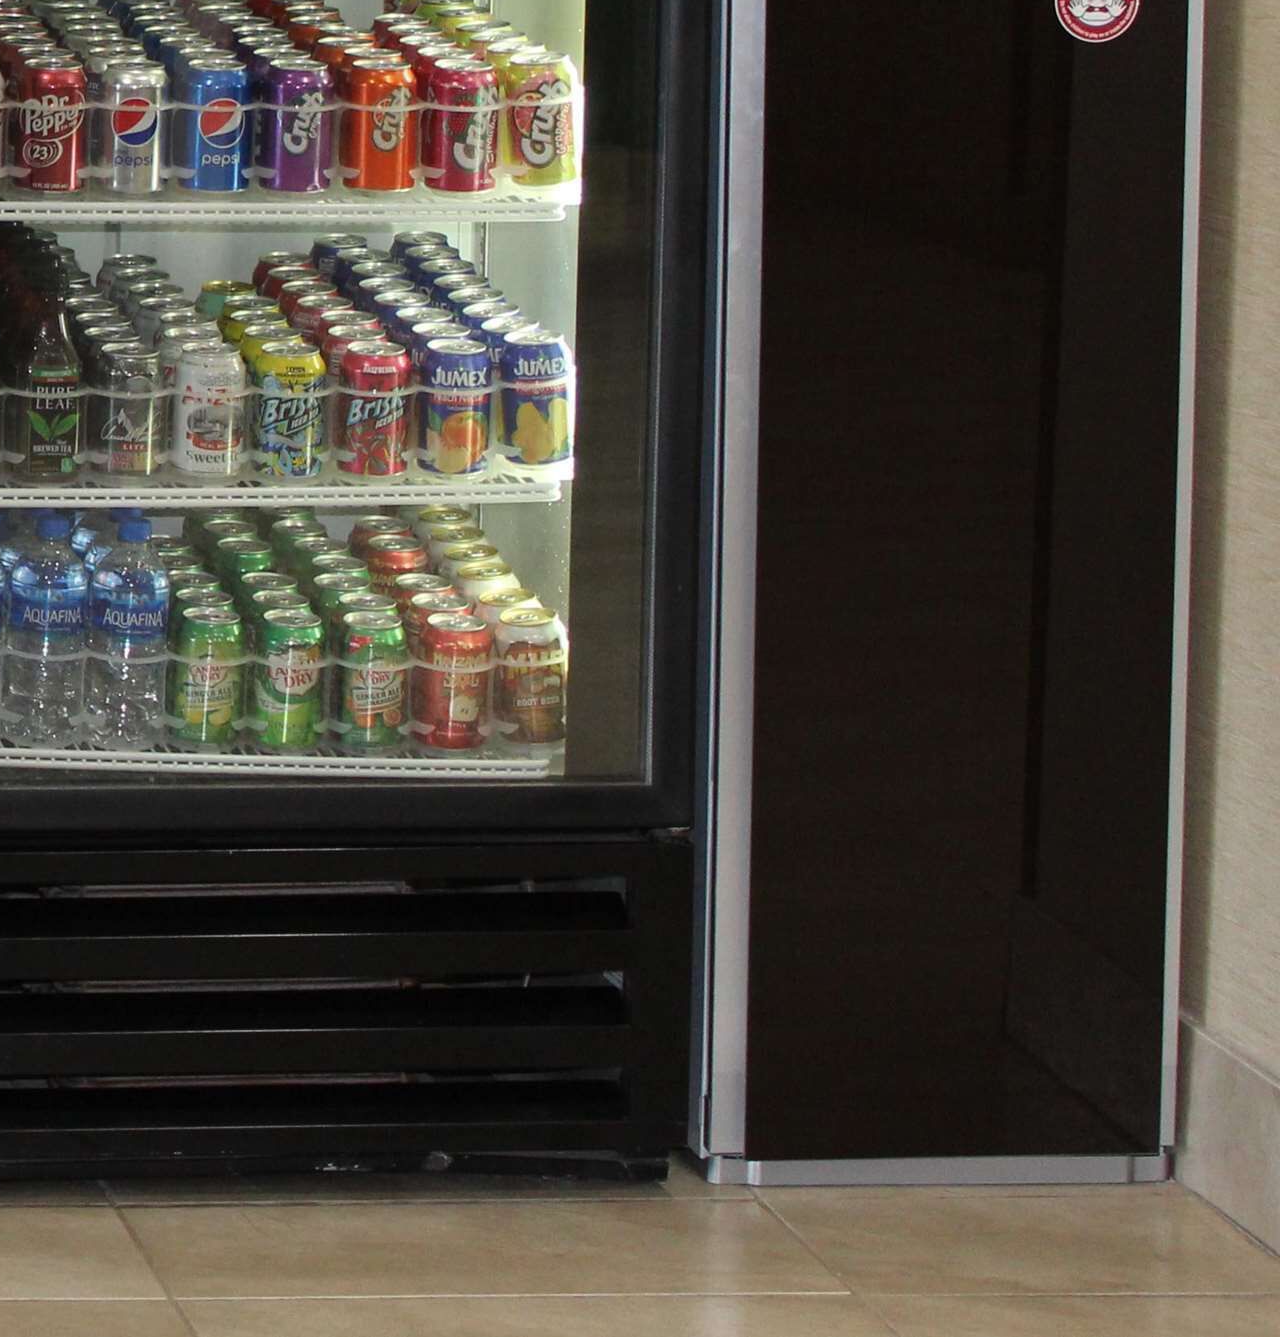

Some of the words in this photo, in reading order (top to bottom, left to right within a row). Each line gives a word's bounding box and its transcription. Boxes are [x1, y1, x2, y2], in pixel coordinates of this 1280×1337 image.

[522, 80, 571, 165] Crush
[32, 144, 50, 158] 23
[431, 366, 487, 389] JUMEX
[36, 399, 74, 410] LEAF
[23, 606, 82, 626] AQUAFINA
[103, 610, 163, 629] AQUAFINA
[283, 672, 314, 688] DRY
